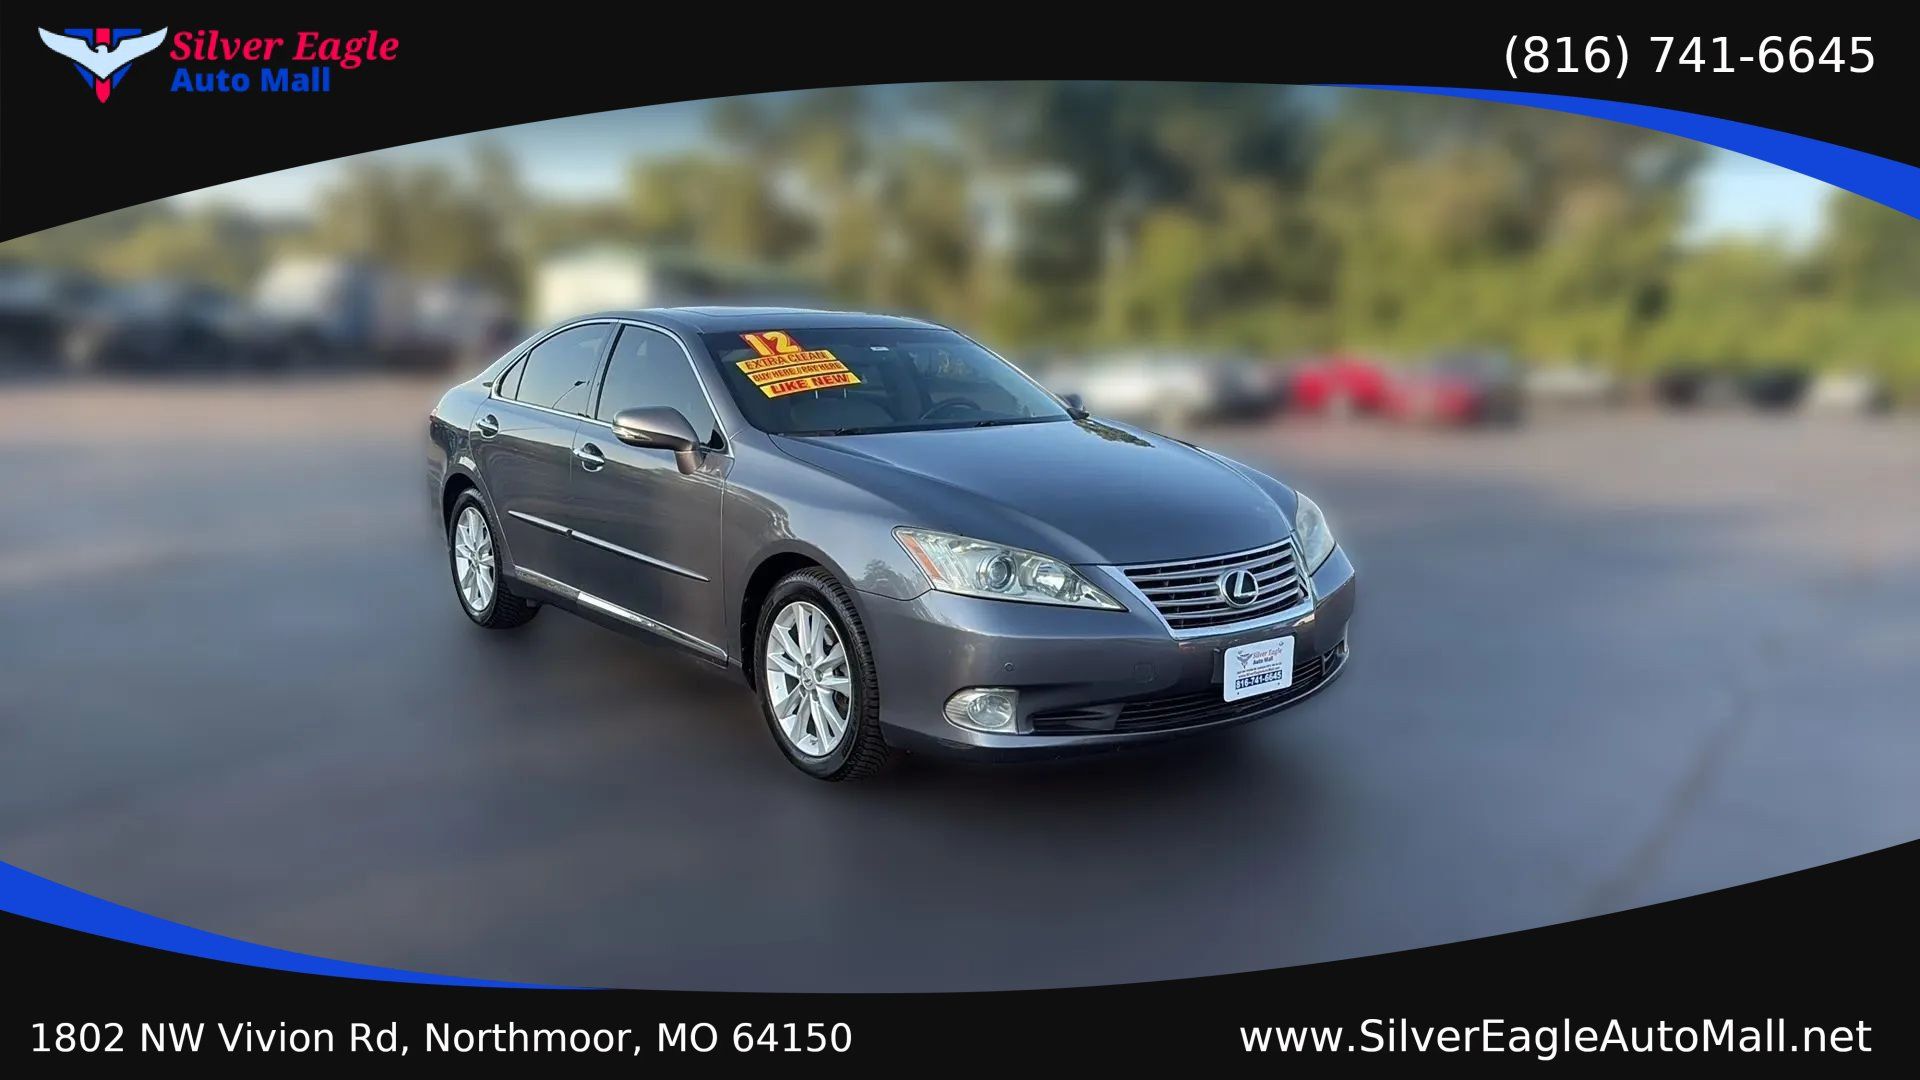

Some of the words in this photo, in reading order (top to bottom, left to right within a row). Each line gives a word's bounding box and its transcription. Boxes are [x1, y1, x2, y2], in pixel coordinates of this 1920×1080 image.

[744, 331, 802, 356] 12
[745, 355, 787, 369] EXTRA
[788, 351, 828, 363] CLEAN
[752, 371, 771, 382] BUY
[818, 362, 843, 370] HERE
[770, 379, 809, 394] LIKE
[811, 374, 849, 386] NEW
[1253, 650, 1268, 658] Silver
[1236, 671, 1282, 688] 816-741-6645
